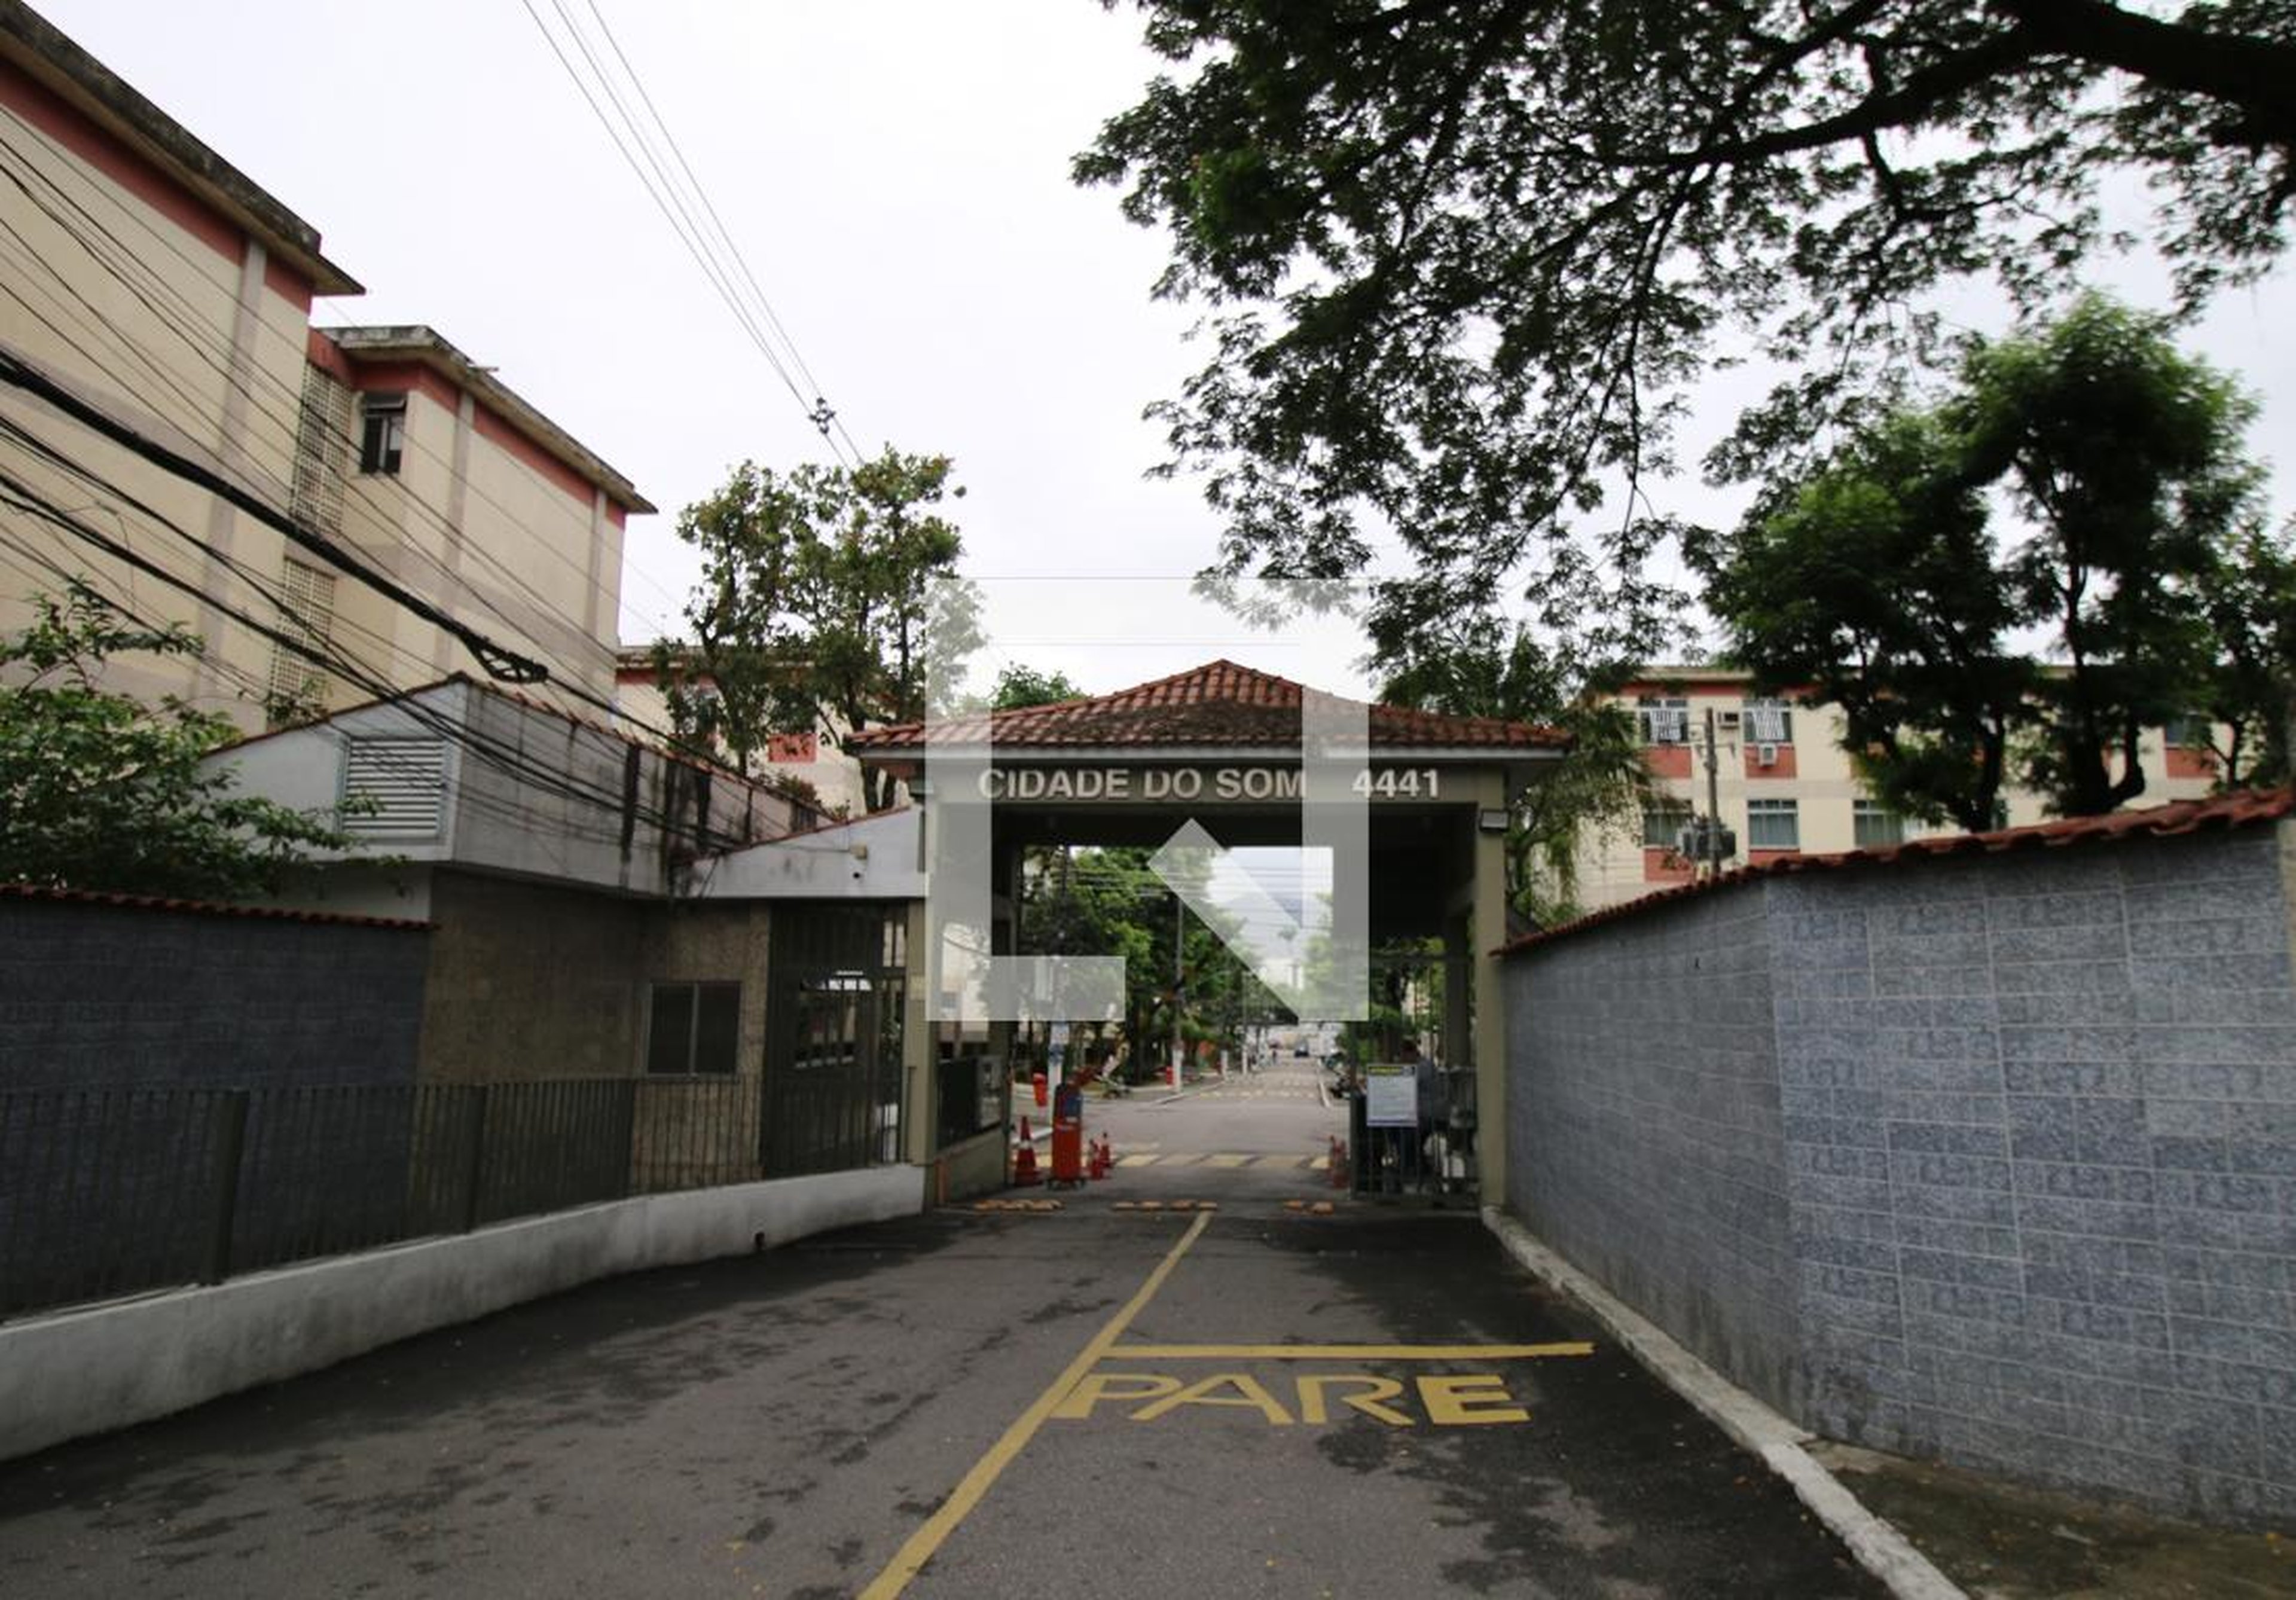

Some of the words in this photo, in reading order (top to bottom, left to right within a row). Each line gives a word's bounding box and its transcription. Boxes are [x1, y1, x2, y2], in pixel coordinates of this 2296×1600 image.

[978, 769, 1129, 799] CIDADE
[1143, 769, 1201, 799] DO
[1216, 769, 1306, 799] SOM
[1351, 769, 1439, 798] 4441
[1049, 1373, 1532, 1427] PARE
